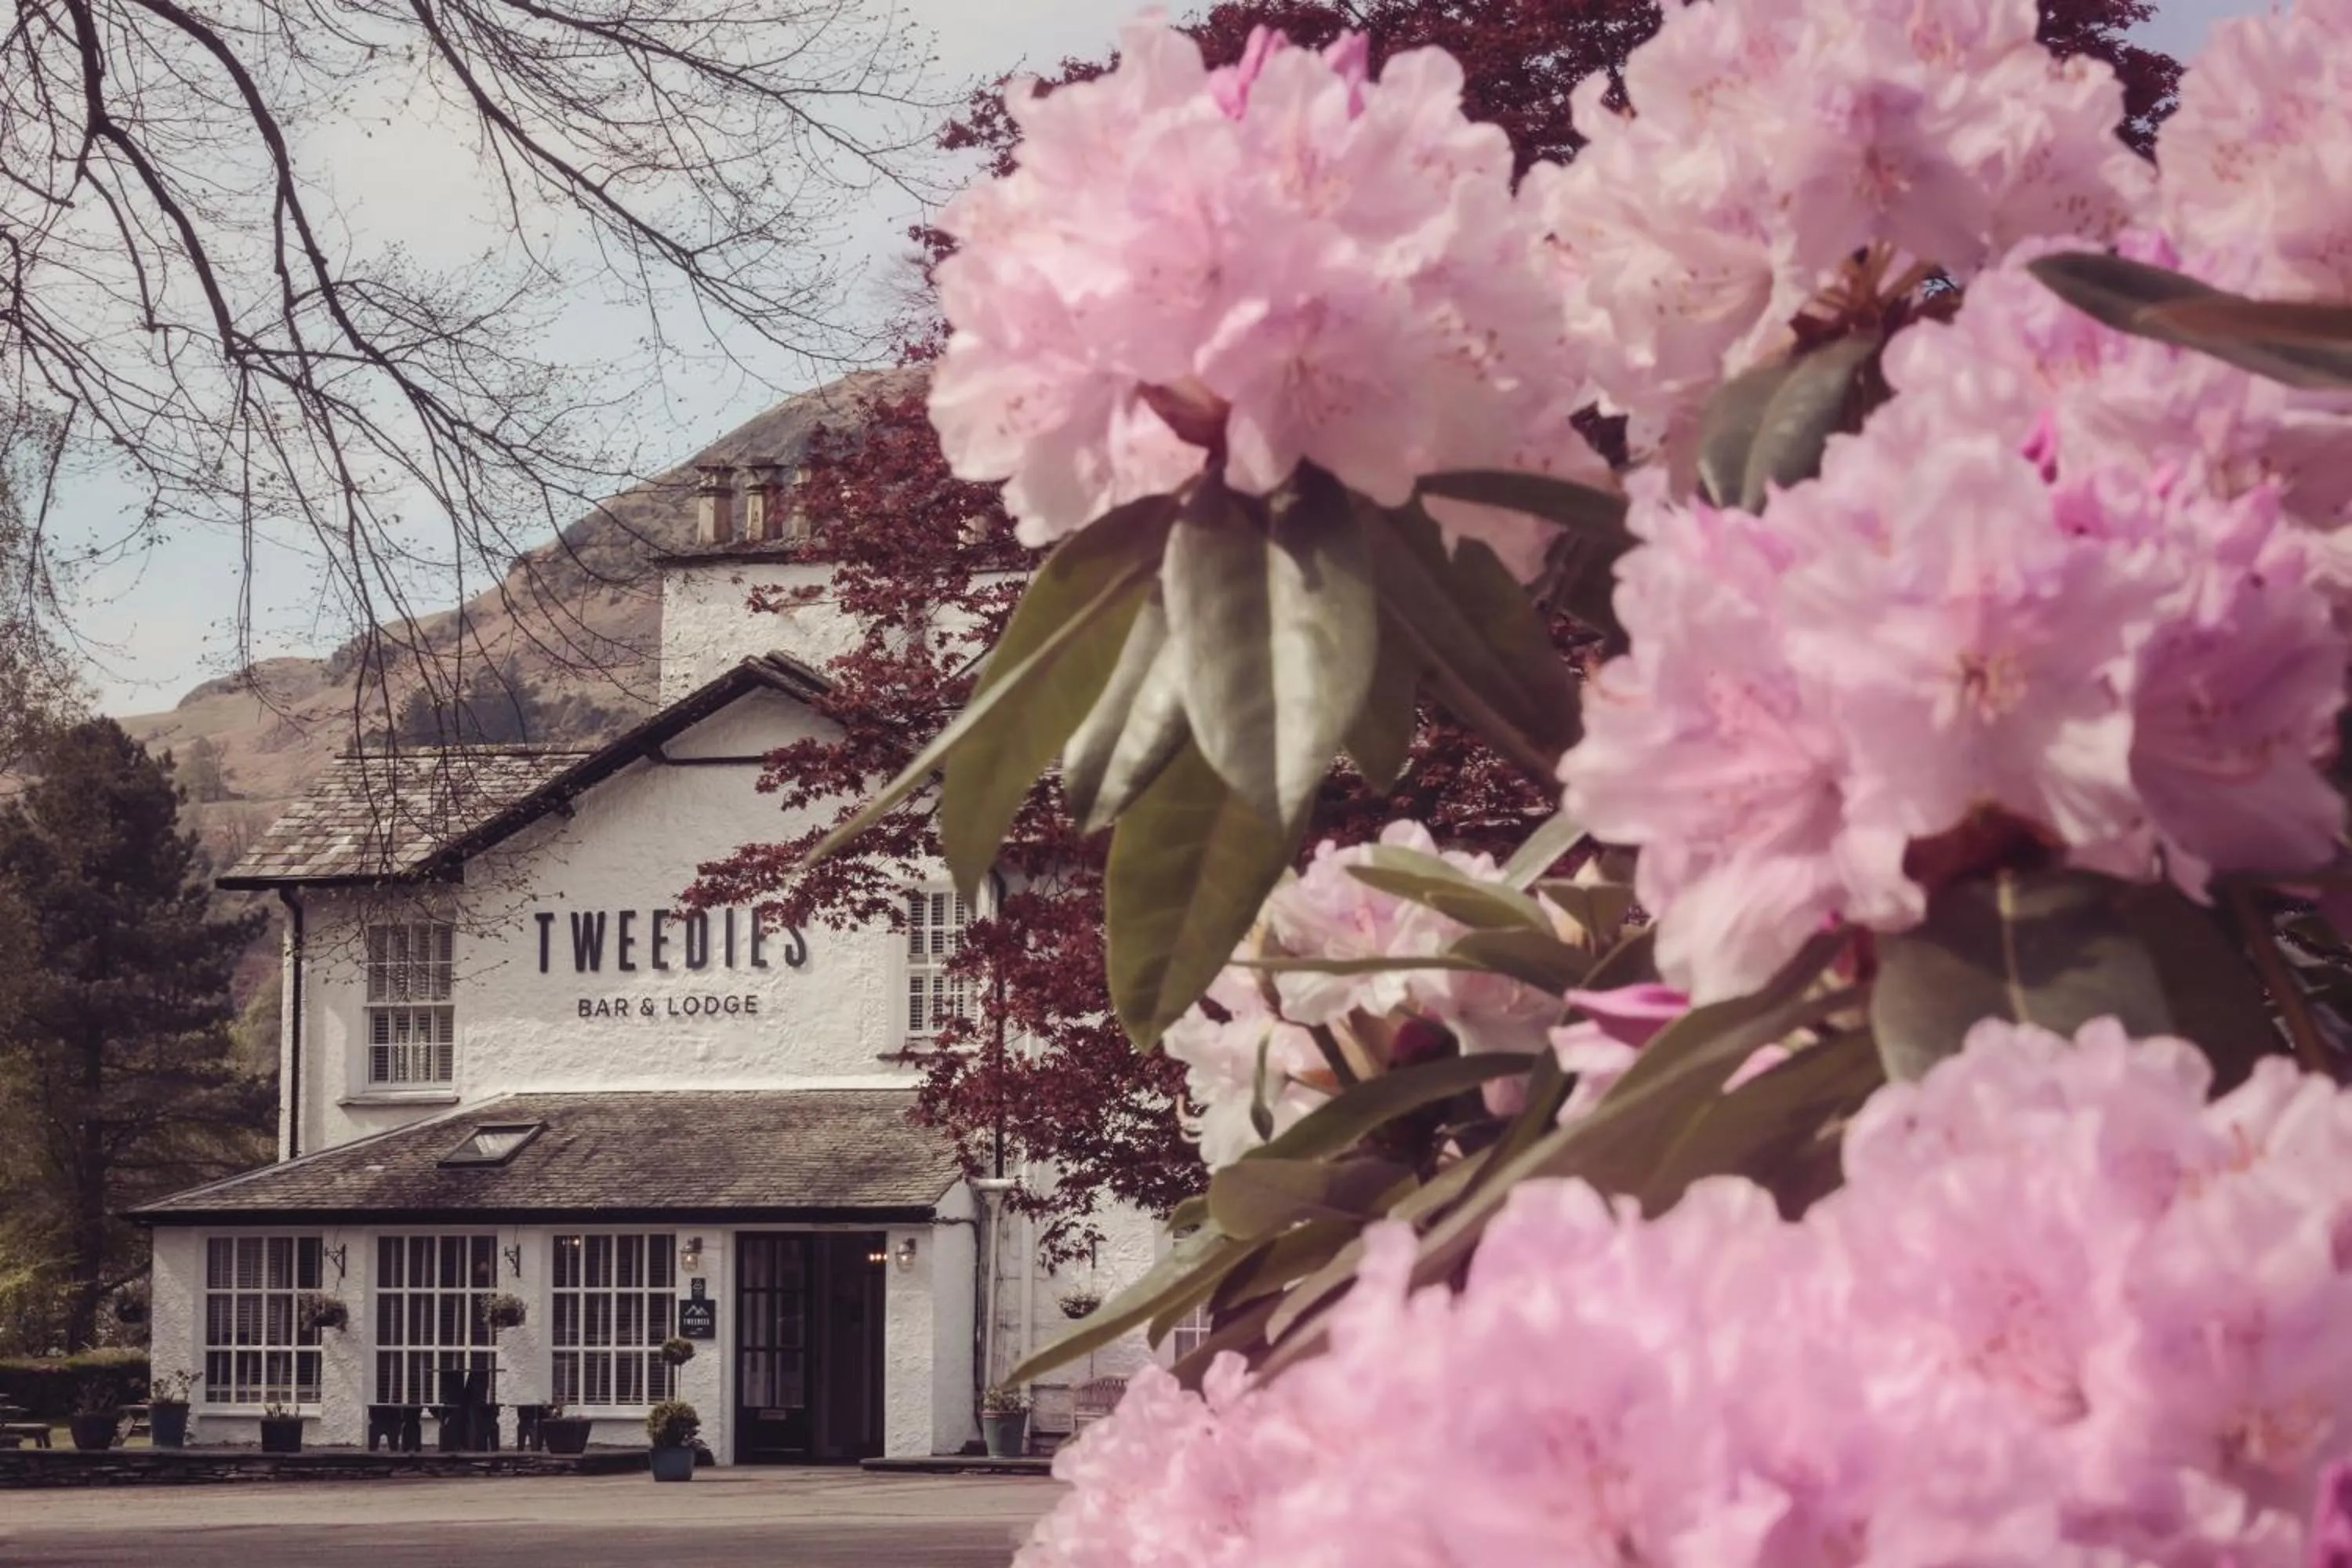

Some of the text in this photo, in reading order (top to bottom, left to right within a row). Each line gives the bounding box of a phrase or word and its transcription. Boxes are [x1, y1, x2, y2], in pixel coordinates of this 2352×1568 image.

[578, 995, 759, 1017] BAR & LODGE
